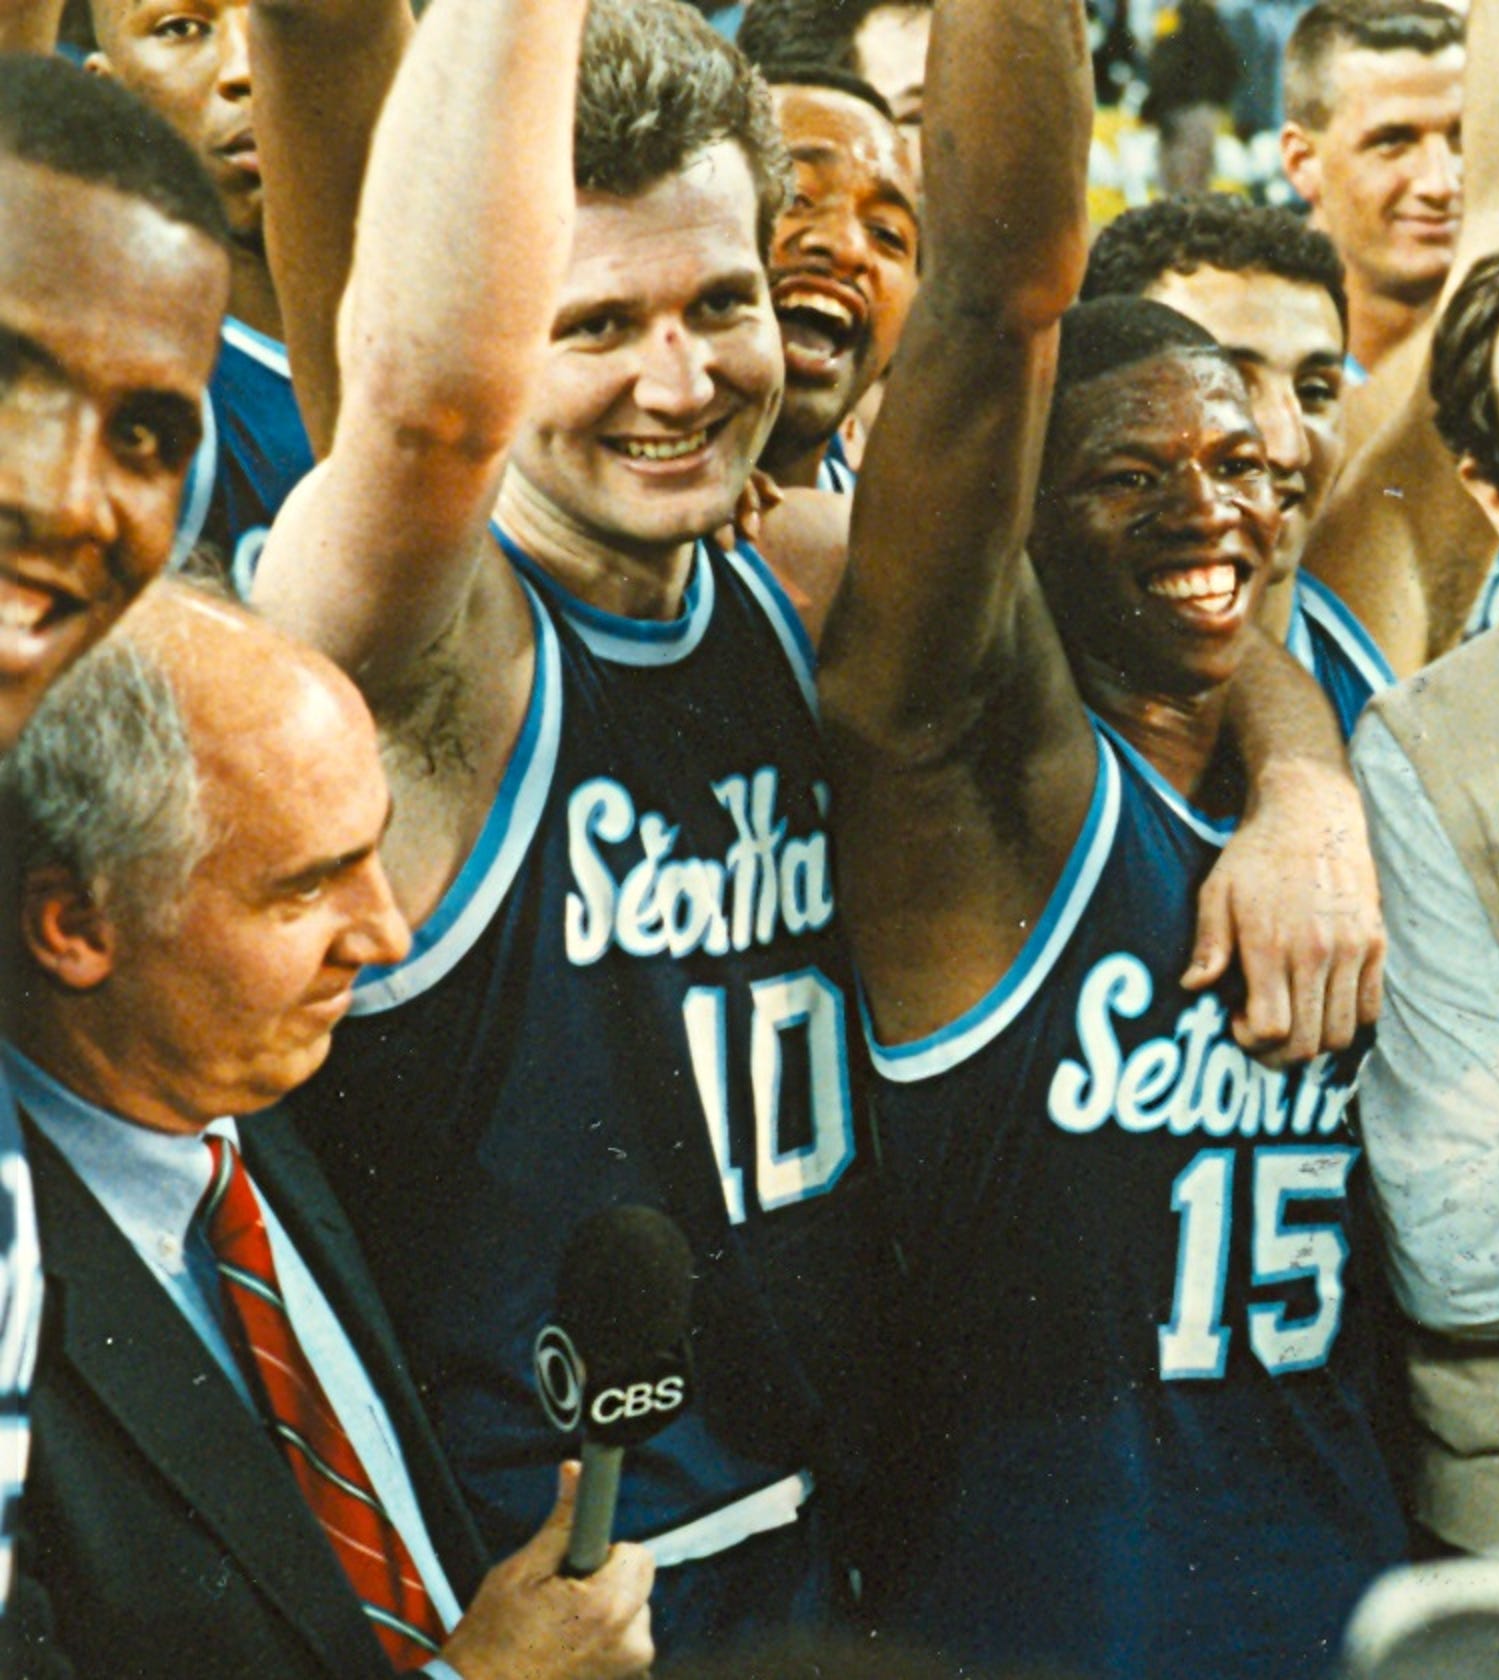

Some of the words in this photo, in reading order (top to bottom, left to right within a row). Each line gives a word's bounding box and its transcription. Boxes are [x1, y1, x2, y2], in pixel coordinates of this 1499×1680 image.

[710, 765, 834, 952] Ha
[682, 964, 856, 1225] 10
[1048, 952, 1287, 1136] Seton
[1158, 1143, 1362, 1380] 15
[591, 1375, 685, 1424] CBS
